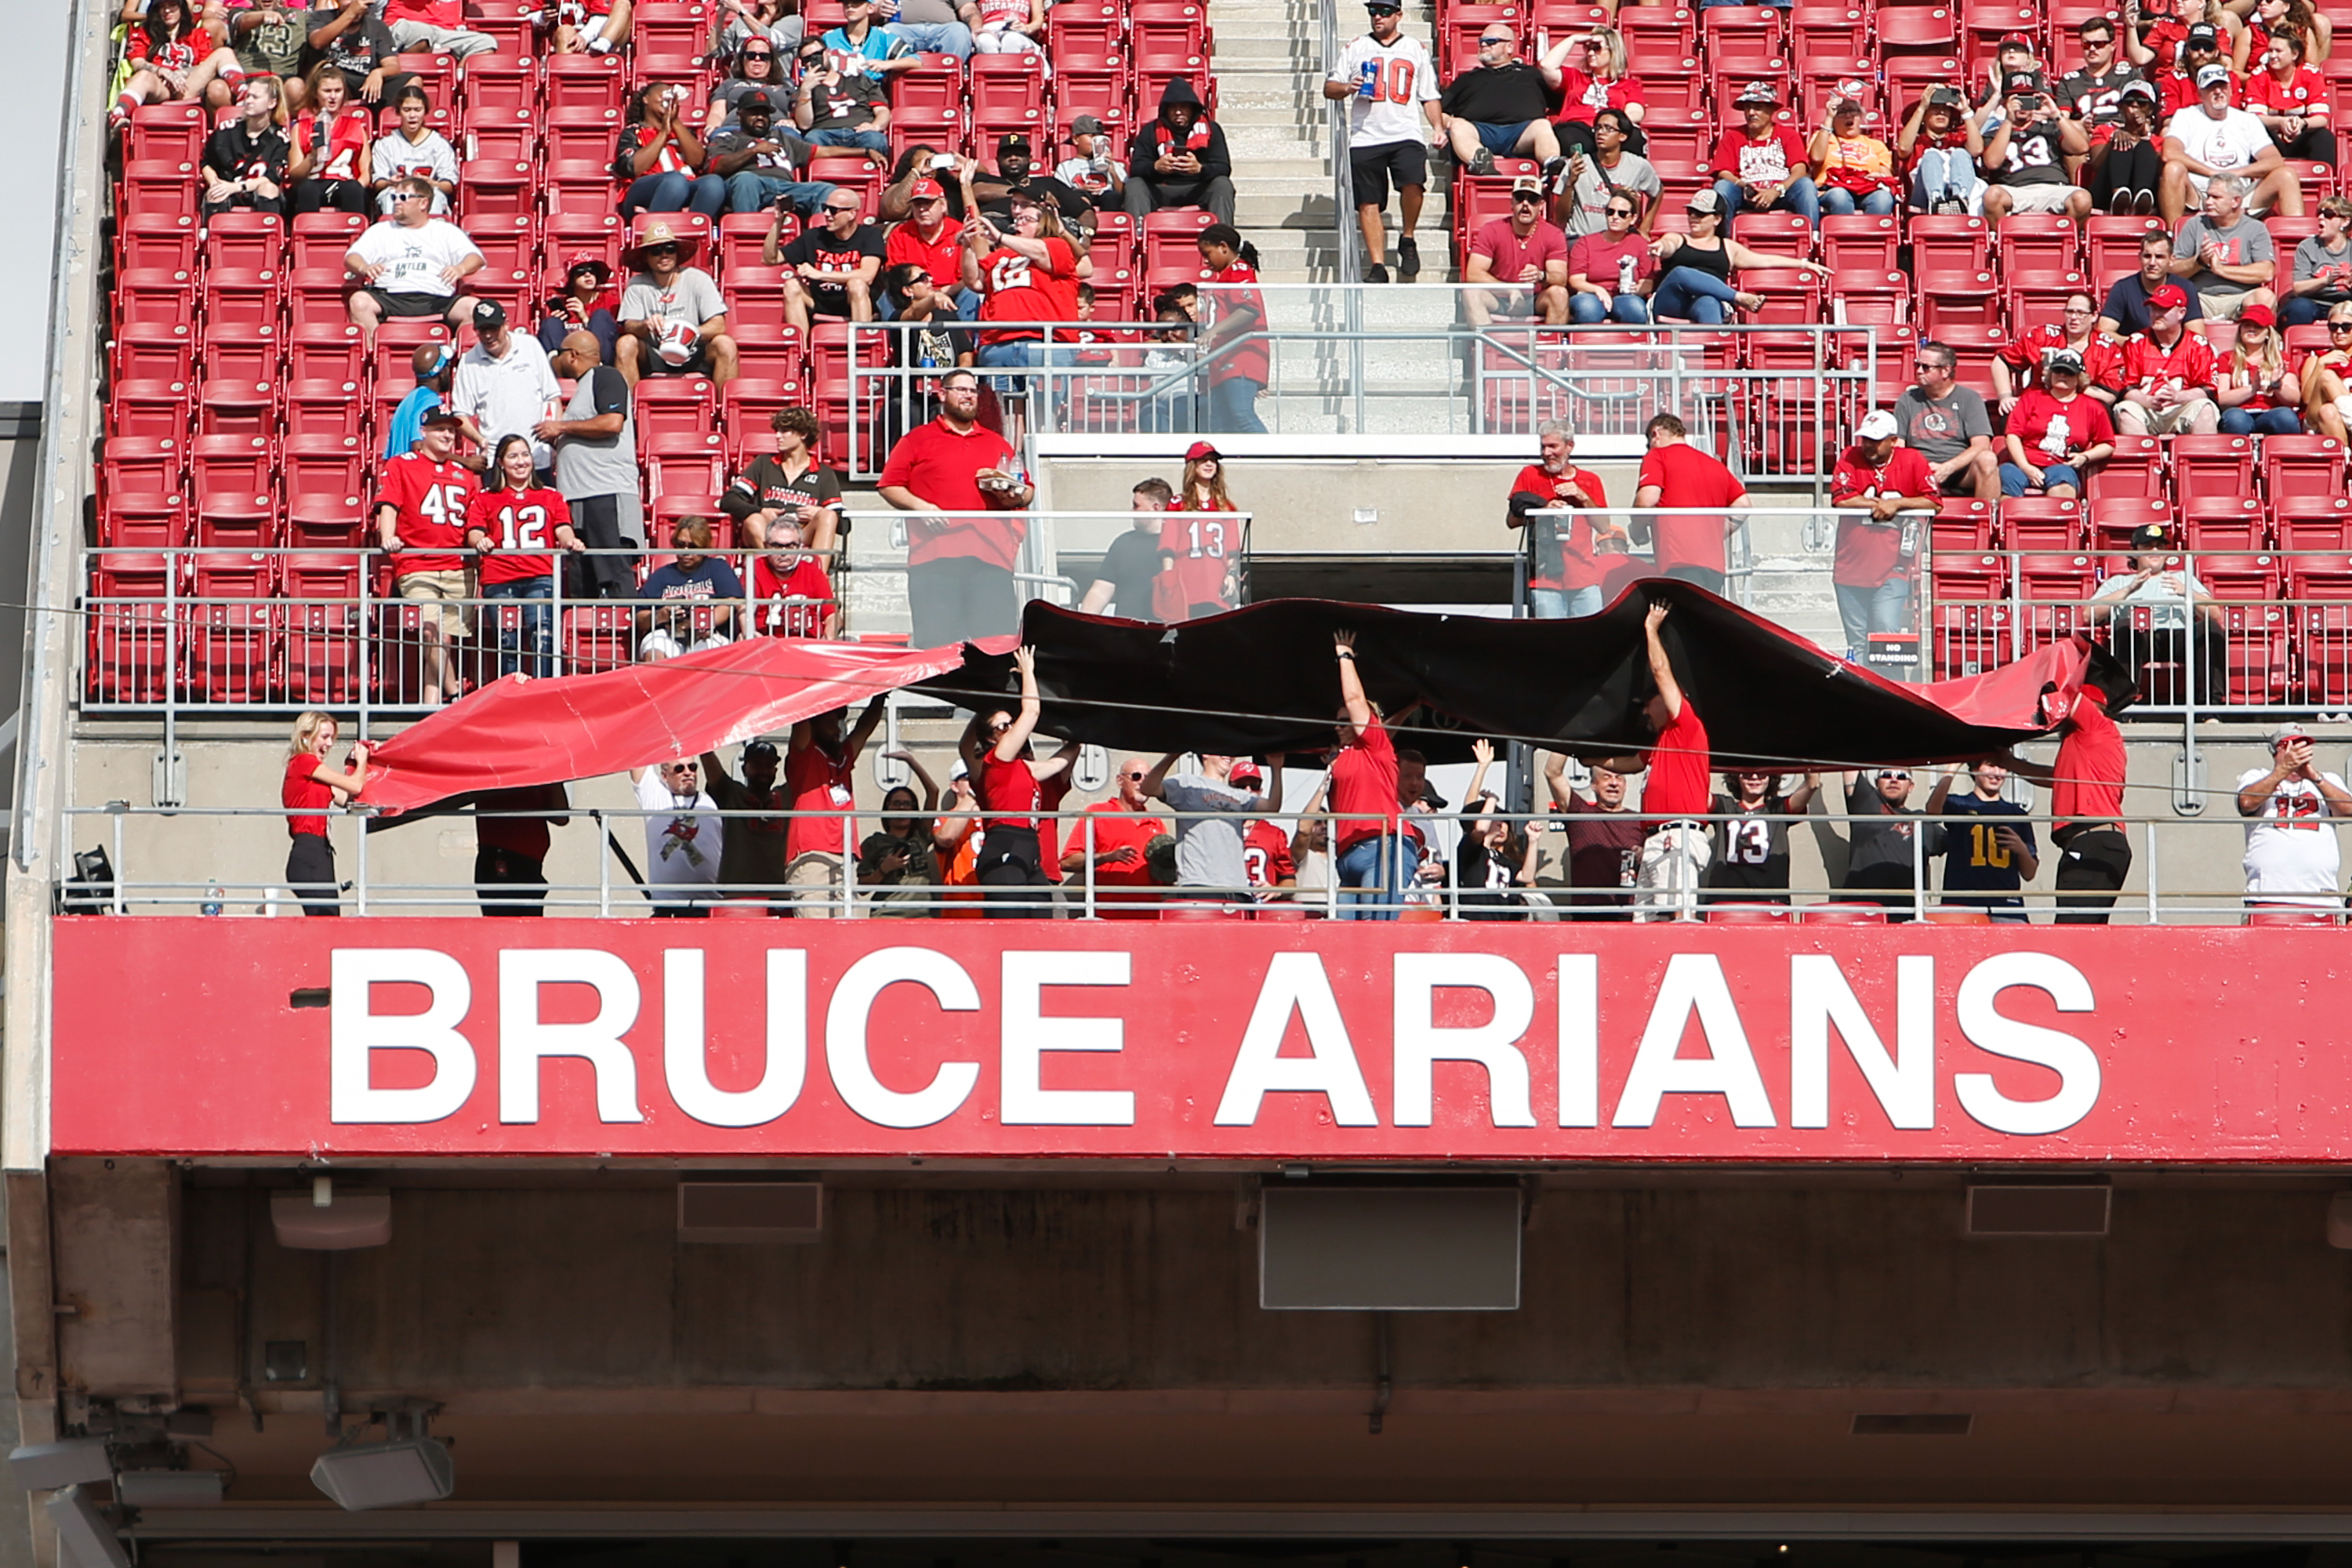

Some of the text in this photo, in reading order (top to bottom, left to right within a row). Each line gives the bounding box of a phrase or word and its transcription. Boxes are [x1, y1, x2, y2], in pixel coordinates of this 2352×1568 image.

[1372, 56, 1417, 105] 10
[2076, 89, 2122, 115] 12
[1009, 134, 1018, 146] P
[2005, 135, 2051, 173] 13
[395, 262, 426, 271] ANTLER
[991, 256, 1032, 292] 12
[419, 483, 466, 528] 45
[498, 506, 547, 550] 12
[1188, 520, 1225, 558] 13
[662, 578, 715, 601] ANGELS
[1869, 654, 1918, 662] STANDING
[1886, 644, 1901, 652] NO
[2274, 792, 2320, 830] 12
[1727, 820, 1769, 863] 13
[331, 946, 2101, 1134] BRUCE ARIANS
